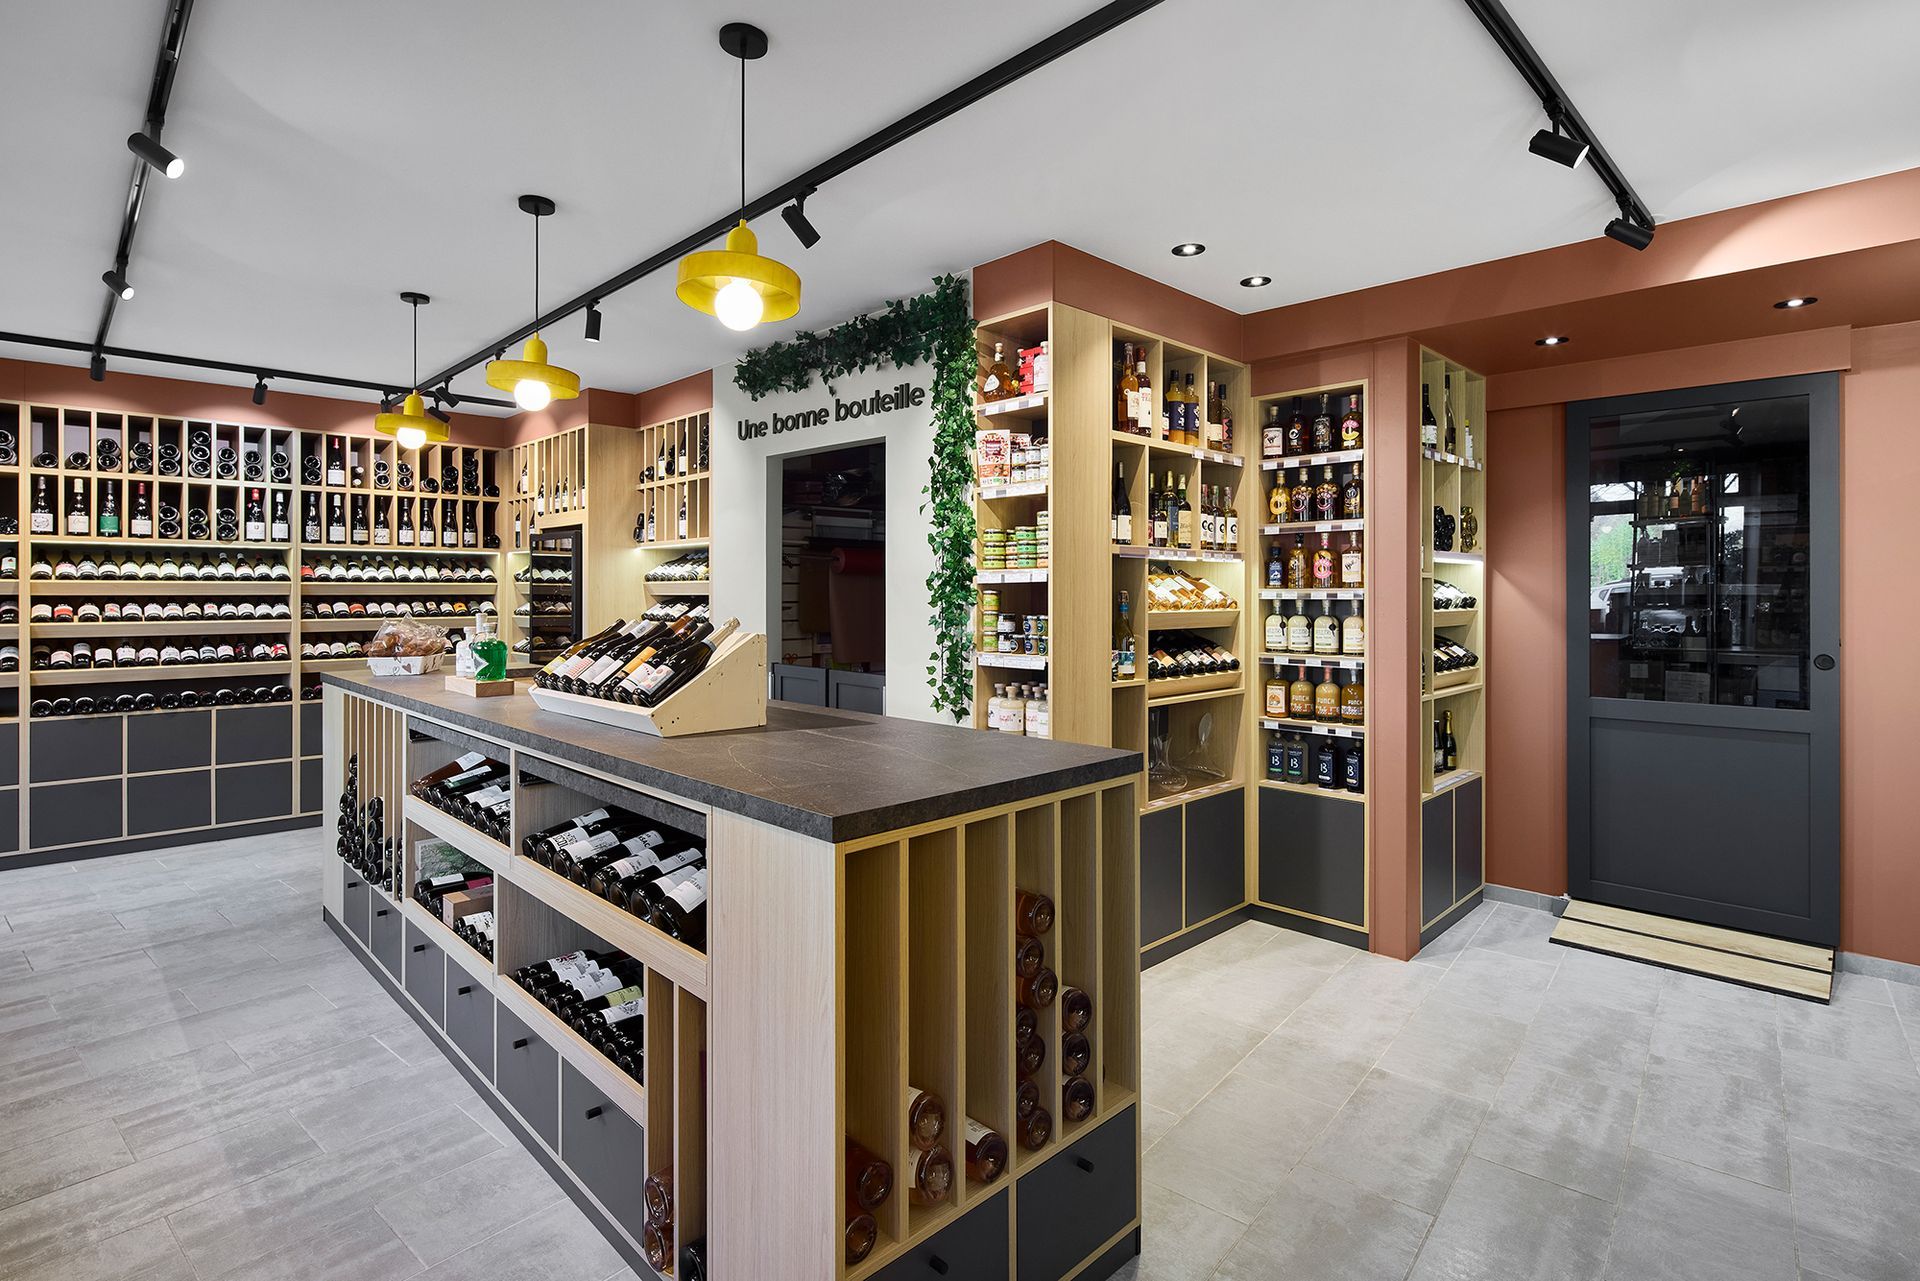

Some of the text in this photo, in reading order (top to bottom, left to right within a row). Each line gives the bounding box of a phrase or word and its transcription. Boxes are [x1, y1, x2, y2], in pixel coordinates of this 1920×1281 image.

[737, 382, 926, 441] Une bonne bouteille
